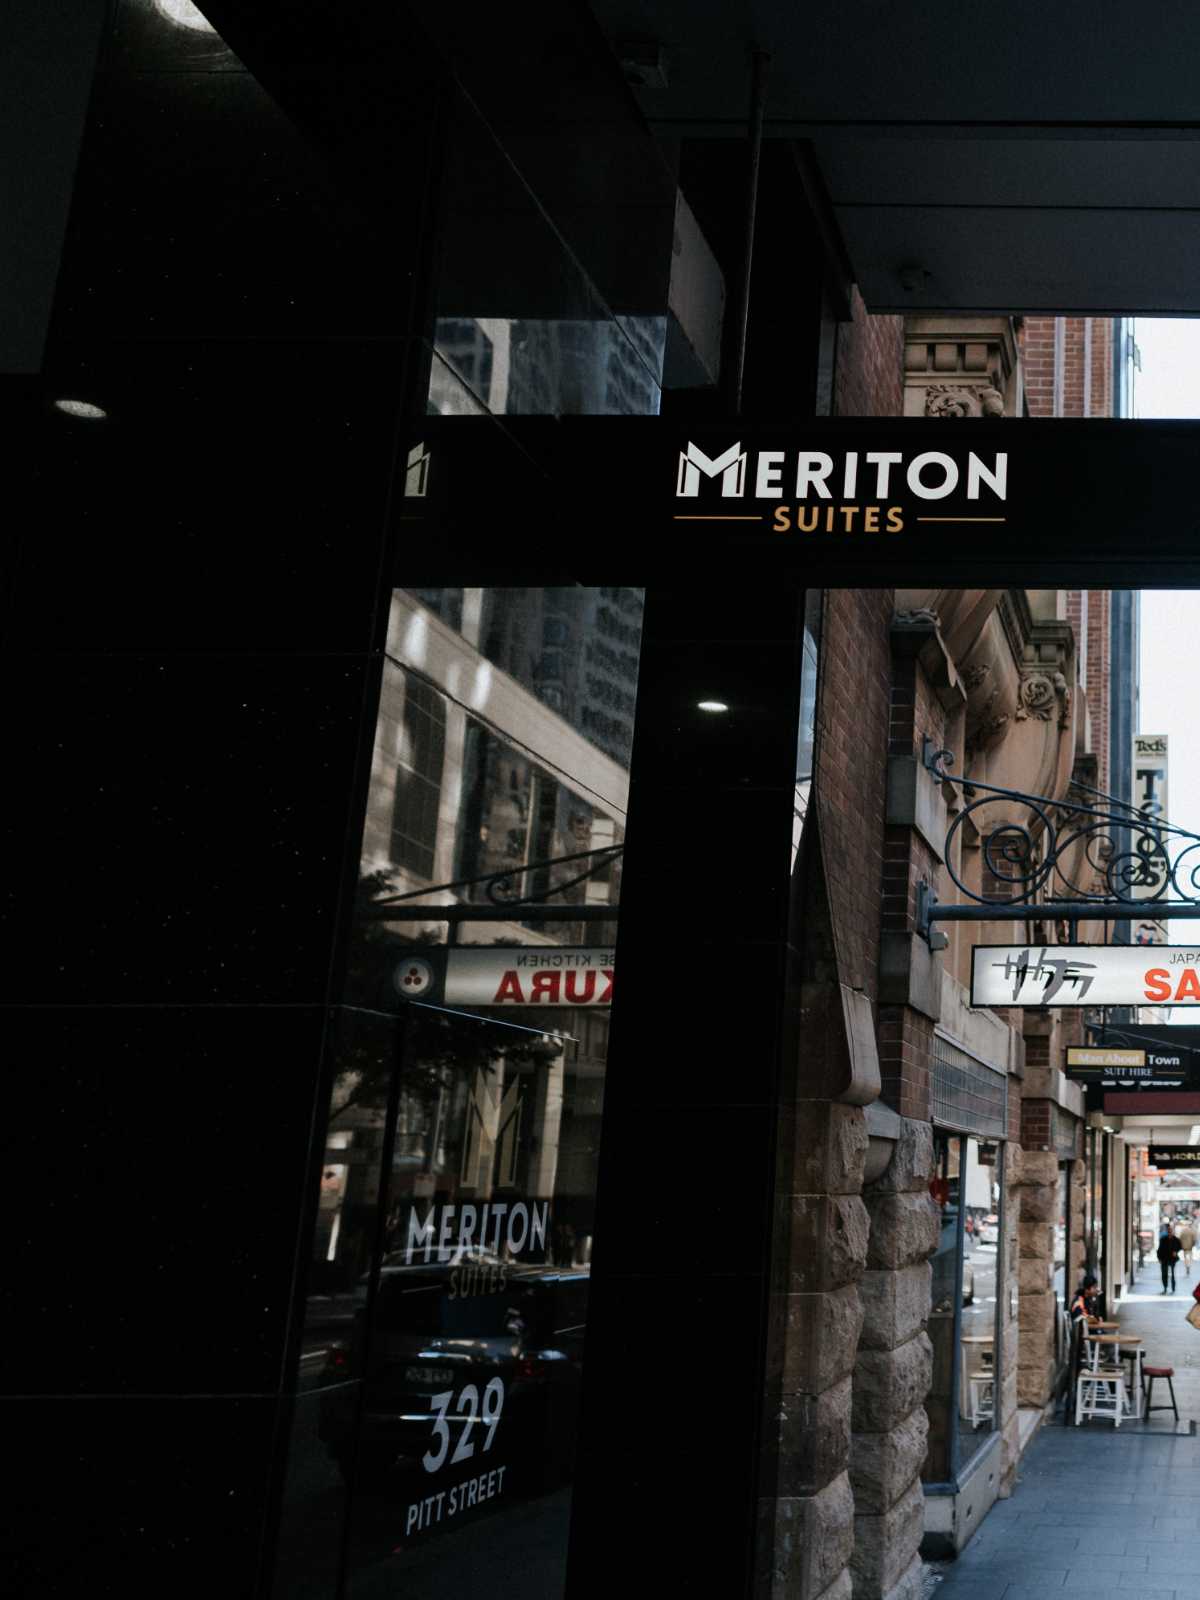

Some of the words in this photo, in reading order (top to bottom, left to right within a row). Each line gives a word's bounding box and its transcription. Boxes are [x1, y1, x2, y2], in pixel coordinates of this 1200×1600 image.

[676, 440, 1008, 501] MERITON
[773, 506, 905, 533] SUITES
[1104, 1067, 1127, 1077] SUIT
[1129, 1067, 1153, 1077] HIRE
[1147, 1054, 1180, 1066] Town
[406, 1201, 549, 1265] MERITON
[421, 1376, 505, 1474] 329
[406, 1492, 446, 1536] PITT
[447, 1466, 507, 1517] STREET
